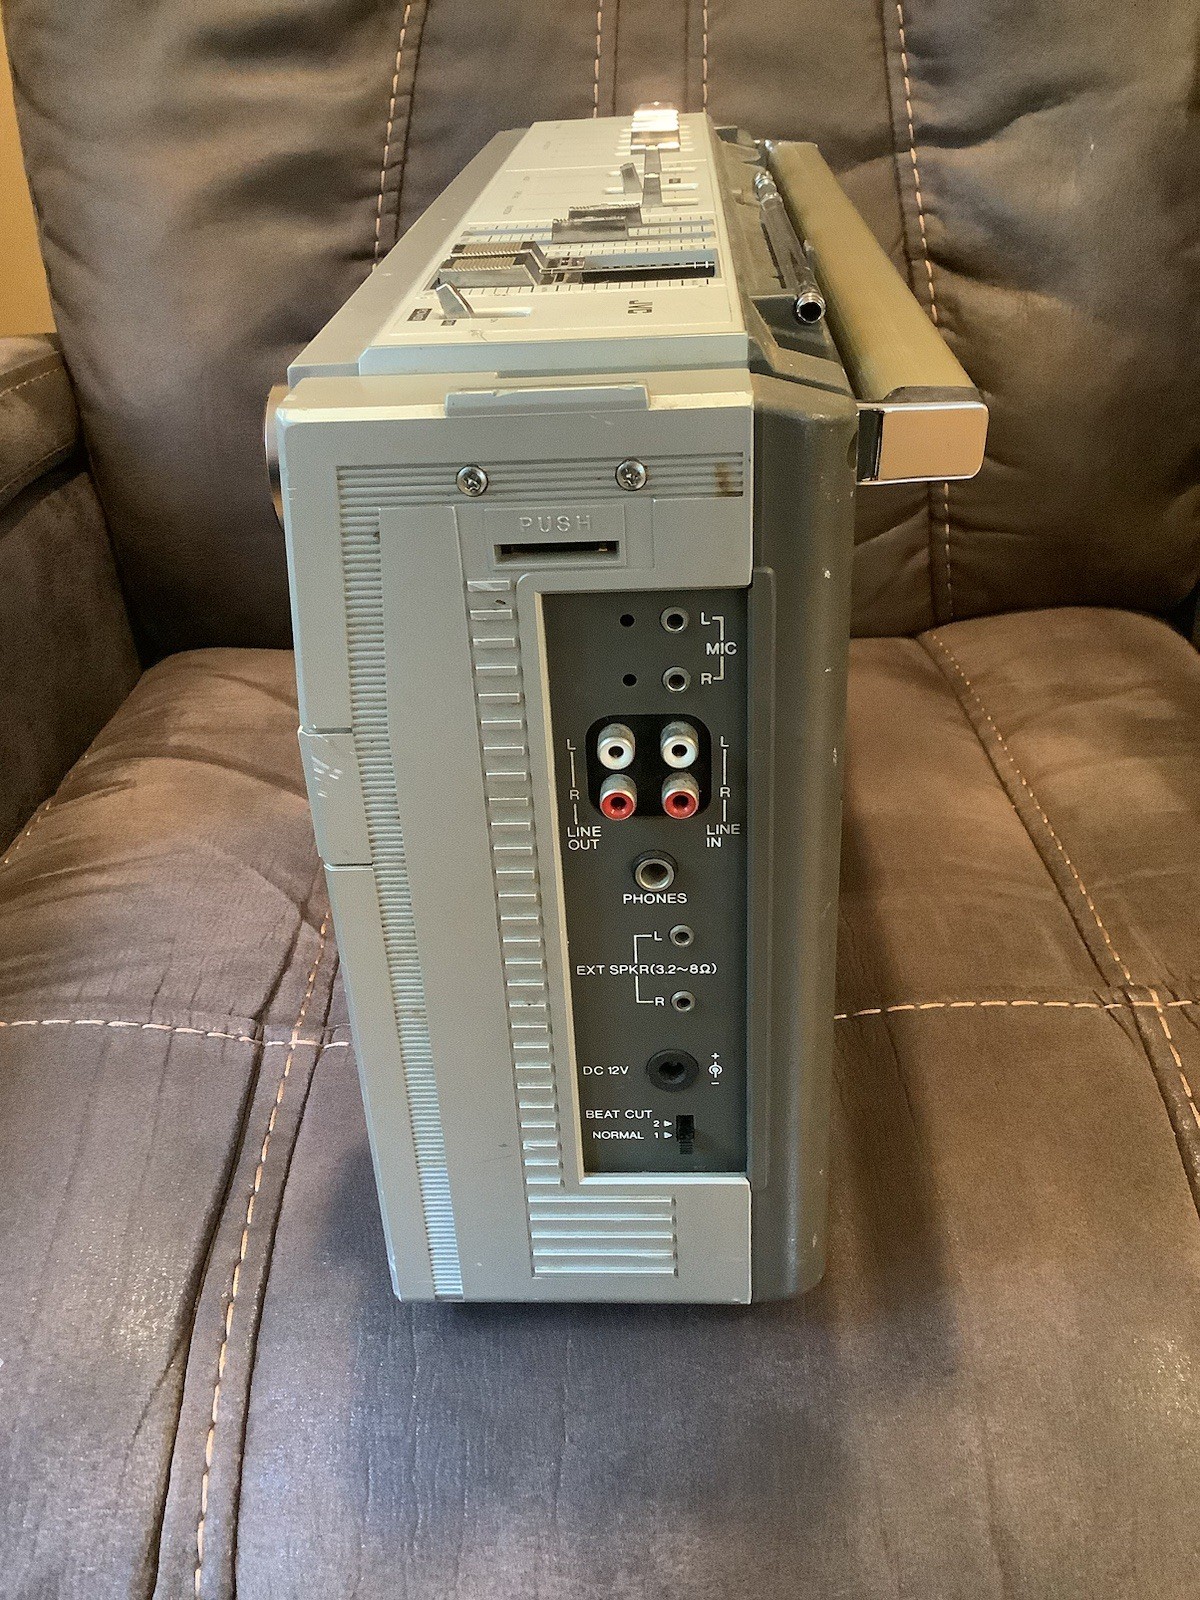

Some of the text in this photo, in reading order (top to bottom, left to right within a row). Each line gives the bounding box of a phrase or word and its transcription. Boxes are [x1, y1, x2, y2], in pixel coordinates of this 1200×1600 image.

[519, 515, 594, 533] PUSH
[700, 612, 711, 625] L
[706, 642, 737, 655] MIC
[700, 672, 712, 685] R
[566, 738, 576, 751] L
[720, 735, 729, 747] L
[569, 789, 580, 800] R
[719, 787, 731, 797] R
[567, 825, 602, 838] LINE
[706, 824, 740, 835] LINE
[568, 839, 600, 850] OUT
[706, 836, 722, 848] IN
[623, 892, 688, 905] PHONES
[653, 931, 662, 941] L
[576, 965, 605, 975] EXT
[654, 996, 665, 1007] R
[583, 1066, 629, 1075] DC 12V
[585, 1109, 653, 1119] BEAT CUT
[653, 1120, 660, 1128] 2
[592, 1131, 645, 1140] NORMAL
